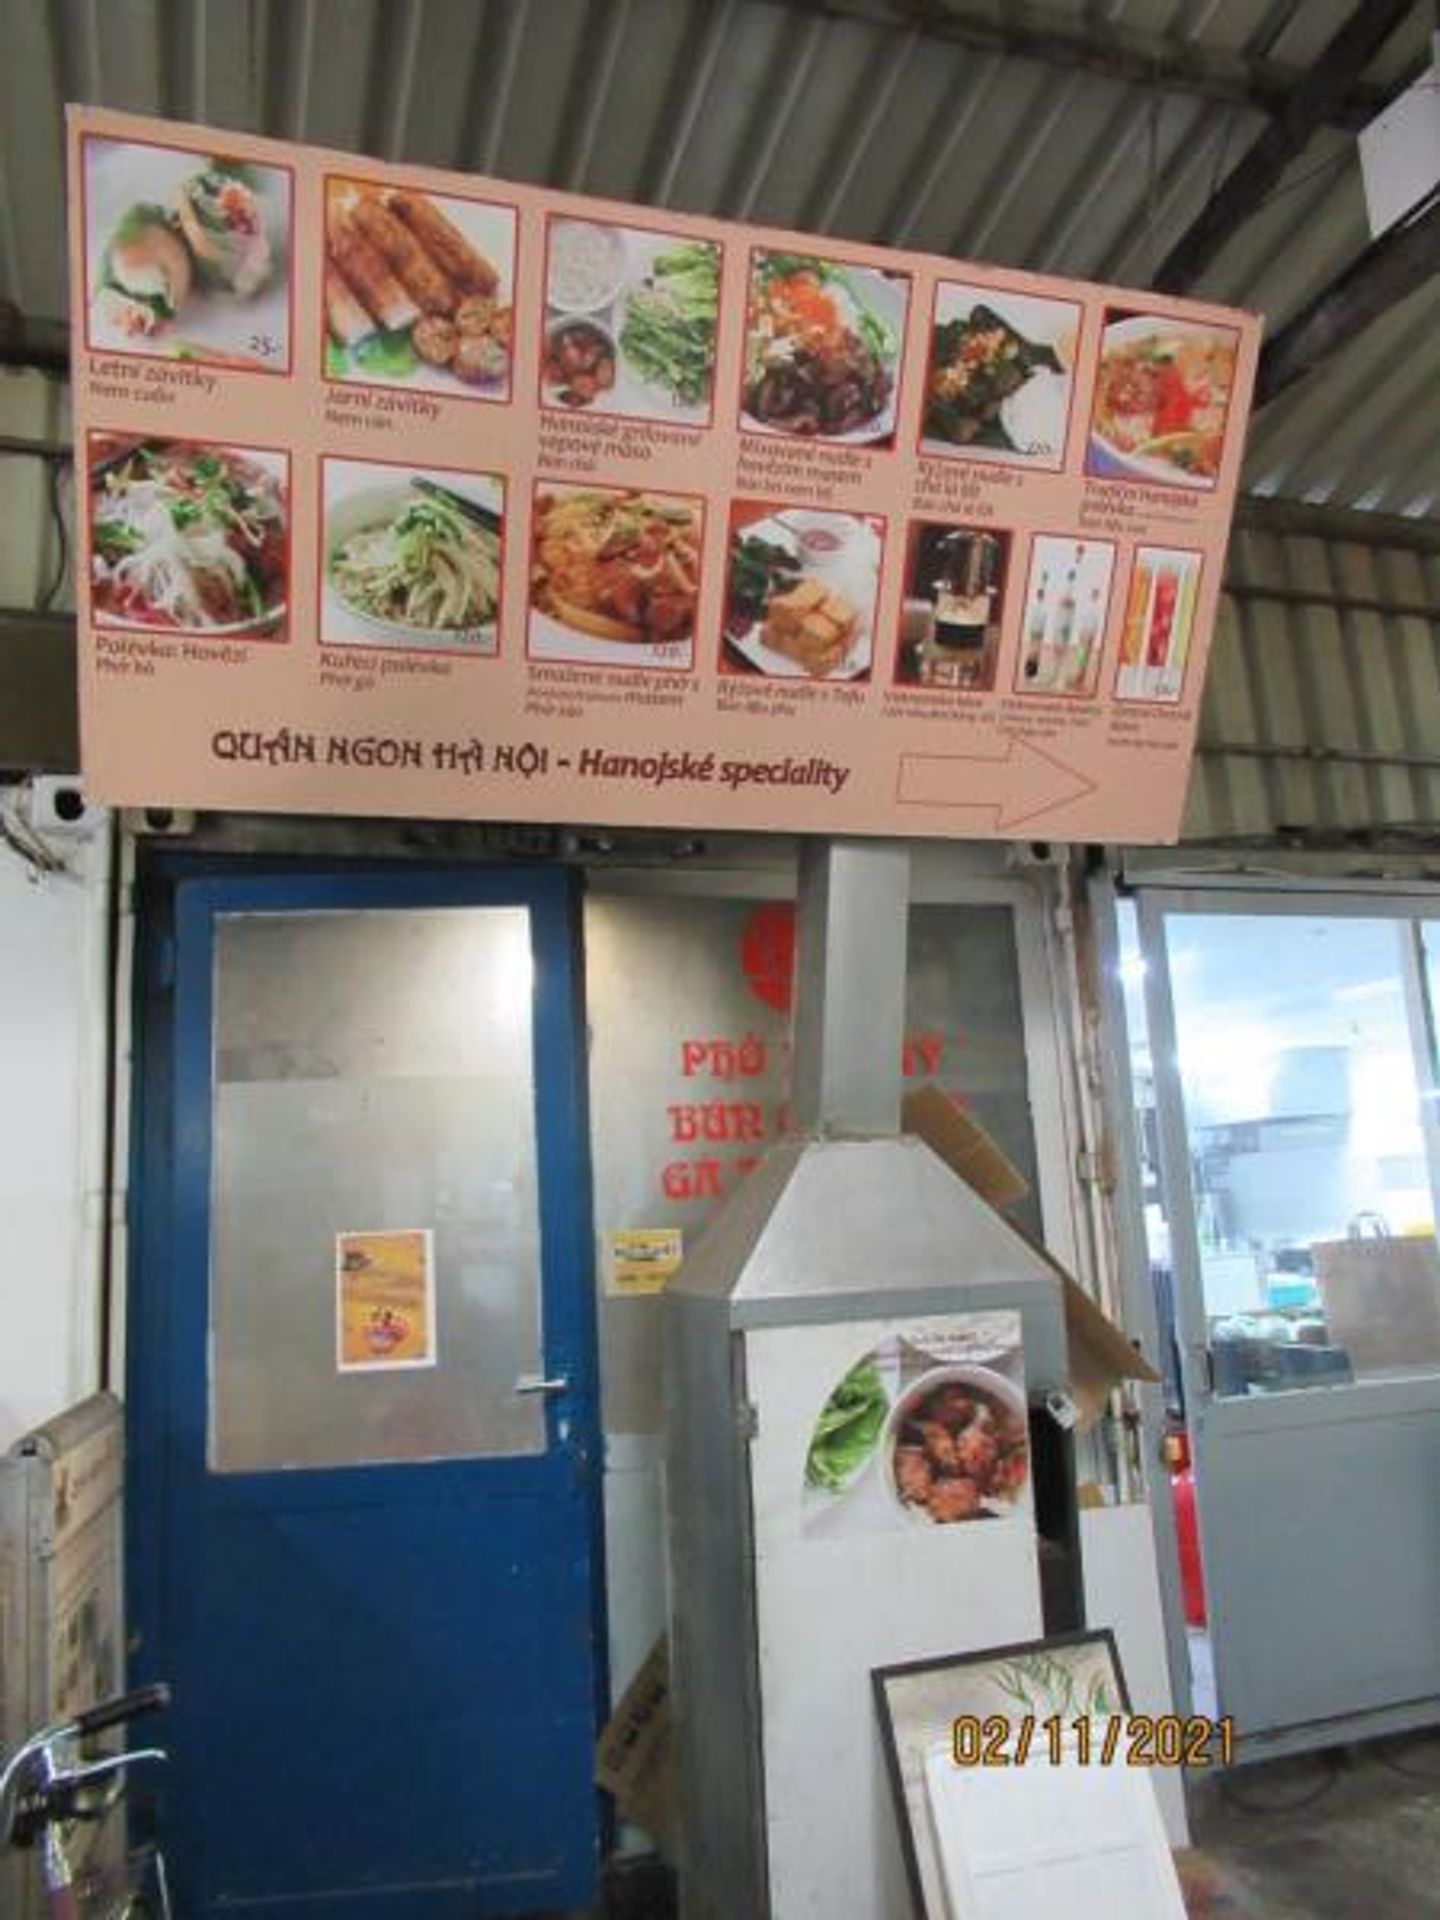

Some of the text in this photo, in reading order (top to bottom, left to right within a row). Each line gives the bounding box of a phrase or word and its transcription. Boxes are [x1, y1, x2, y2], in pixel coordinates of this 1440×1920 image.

[326, 736, 423, 769] NGON
[578, 749, 715, 786] Hanojské
[719, 758, 851, 795] speciality
